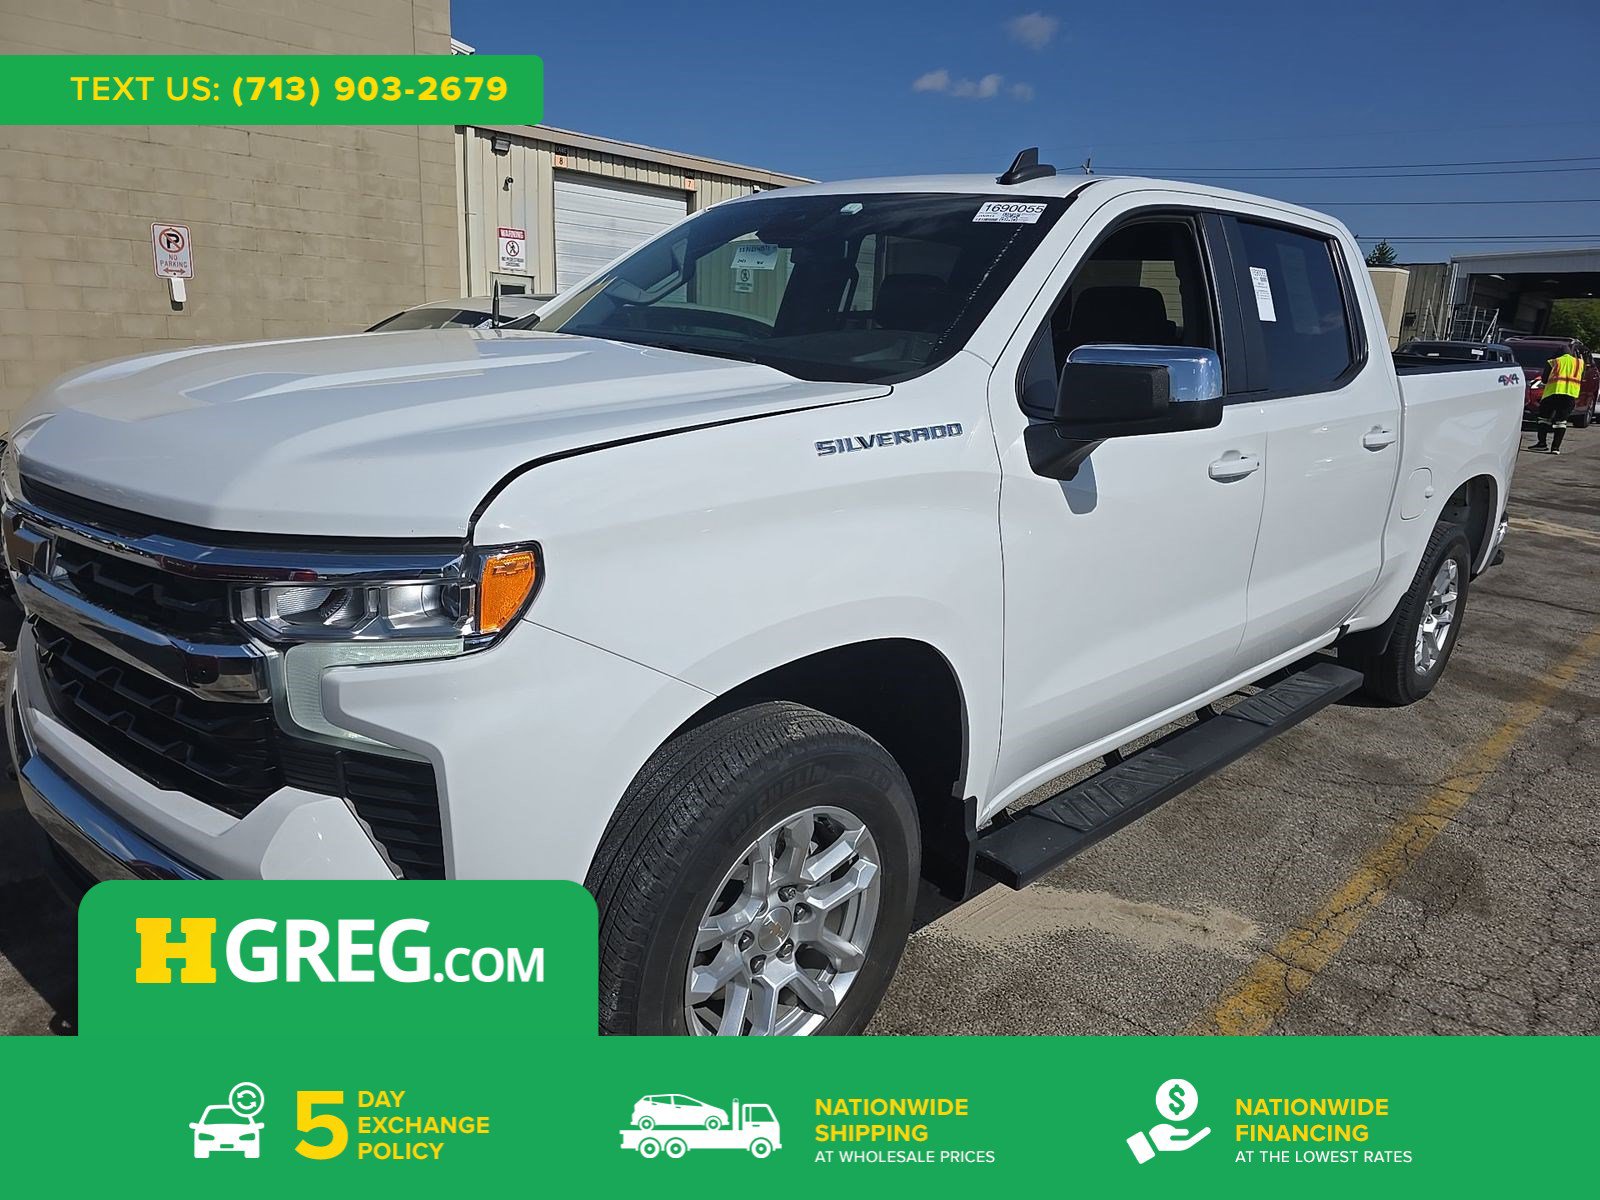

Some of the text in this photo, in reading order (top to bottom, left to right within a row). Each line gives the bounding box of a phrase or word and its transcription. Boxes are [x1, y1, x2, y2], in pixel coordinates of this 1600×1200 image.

[558, 157, 564, 166] 8
[985, 203, 1045, 213] 1690055
[160, 259, 188, 268] PARKING
[814, 422, 964, 457] SILVERADO
